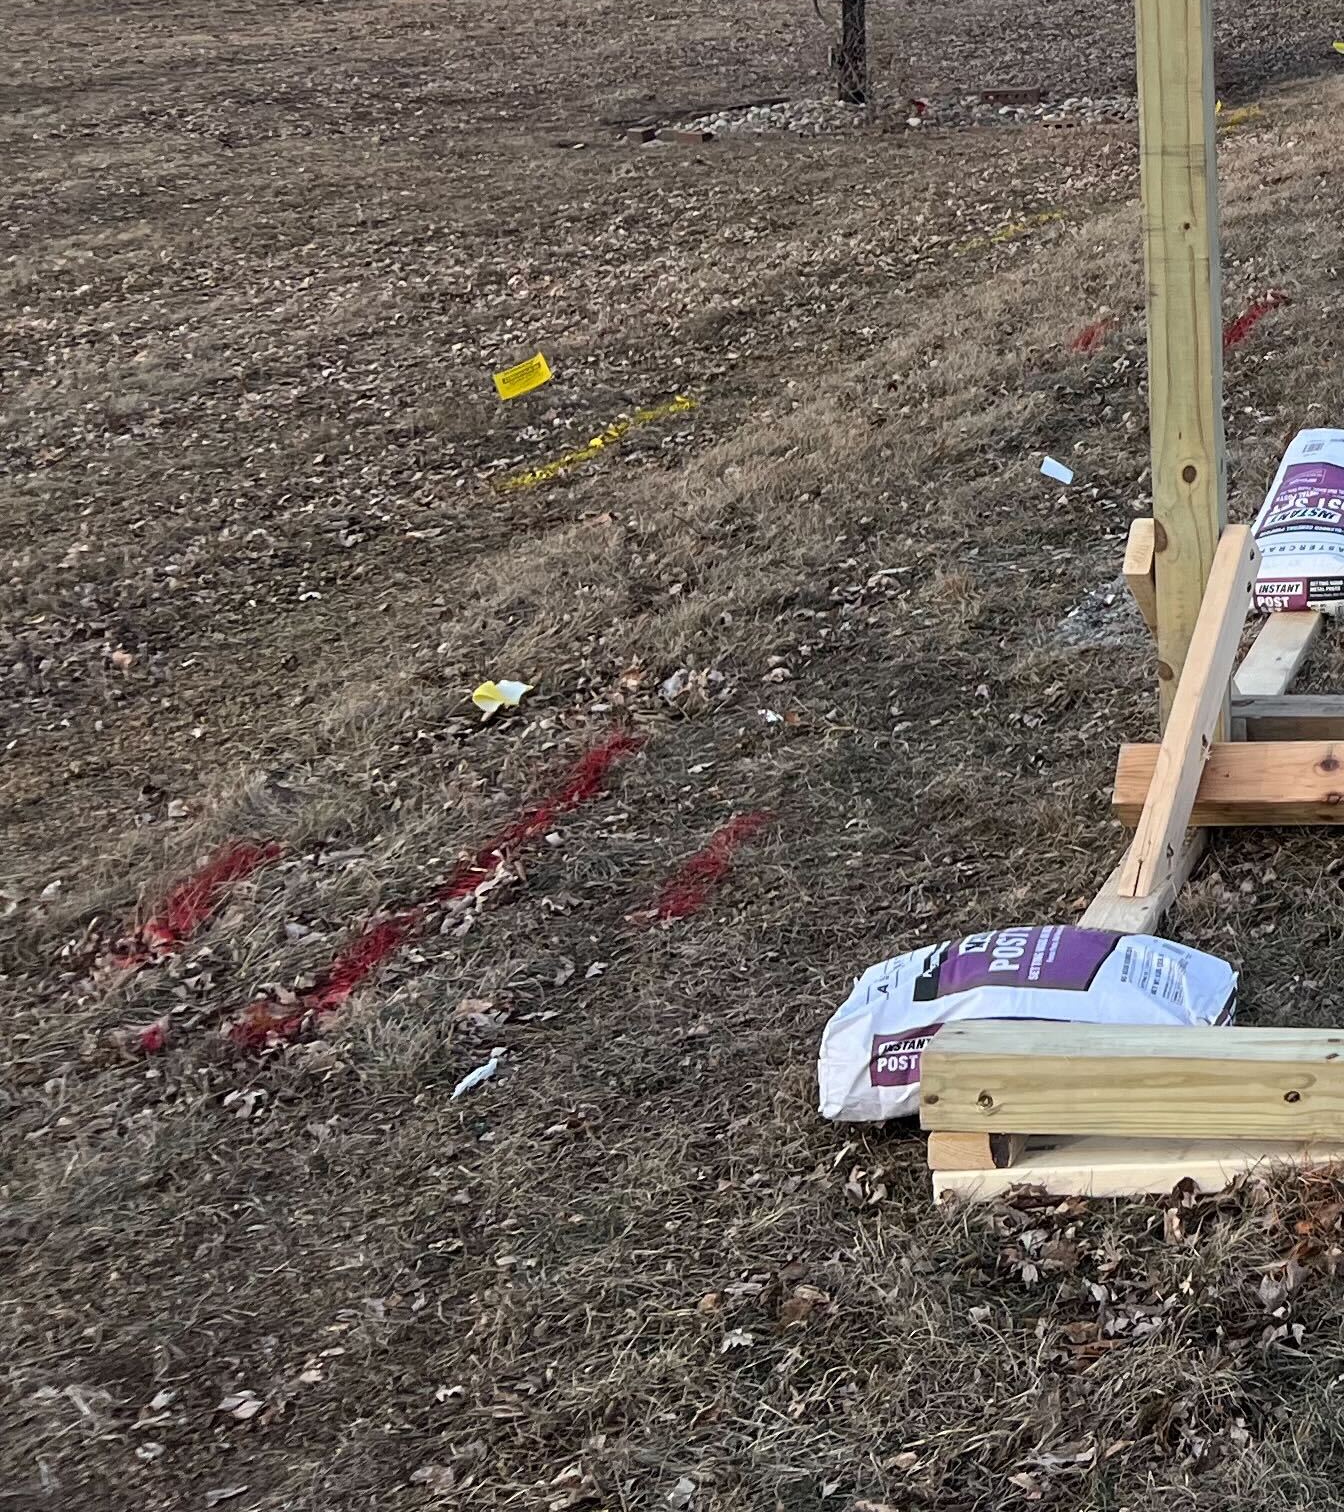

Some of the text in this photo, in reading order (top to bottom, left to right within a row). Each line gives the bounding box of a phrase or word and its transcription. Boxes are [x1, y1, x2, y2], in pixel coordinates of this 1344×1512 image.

[1258, 582, 1301, 594] INSTANT
[1256, 595, 1290, 608] POST
[877, 1054, 919, 1073] POST
